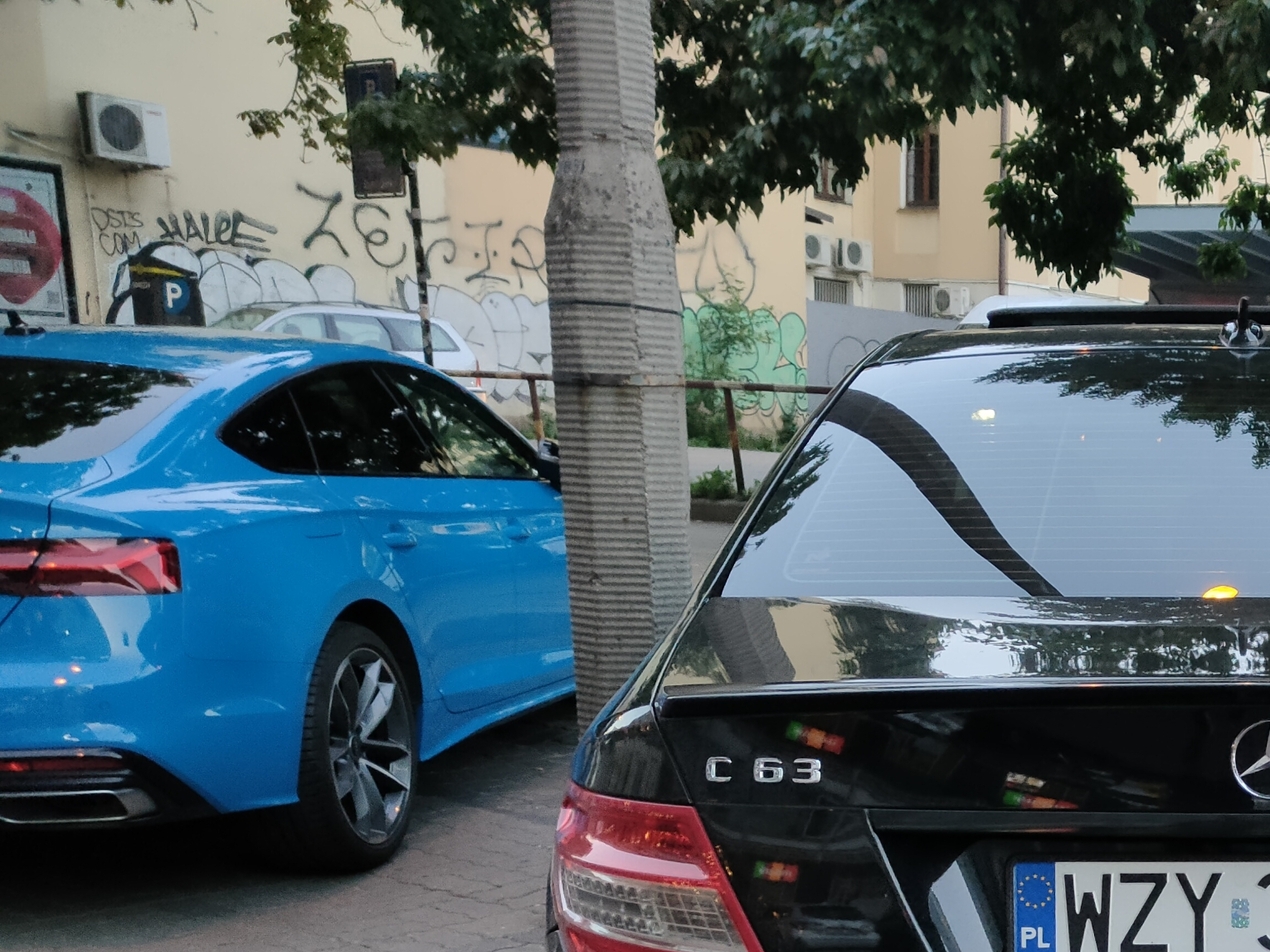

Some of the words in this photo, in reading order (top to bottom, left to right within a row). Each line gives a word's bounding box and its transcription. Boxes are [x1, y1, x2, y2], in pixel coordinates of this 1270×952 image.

[165, 281, 183, 309] P
[705, 756, 732, 782] C
[753, 757, 821, 783] 63
[1020, 926, 1051, 949] PL
